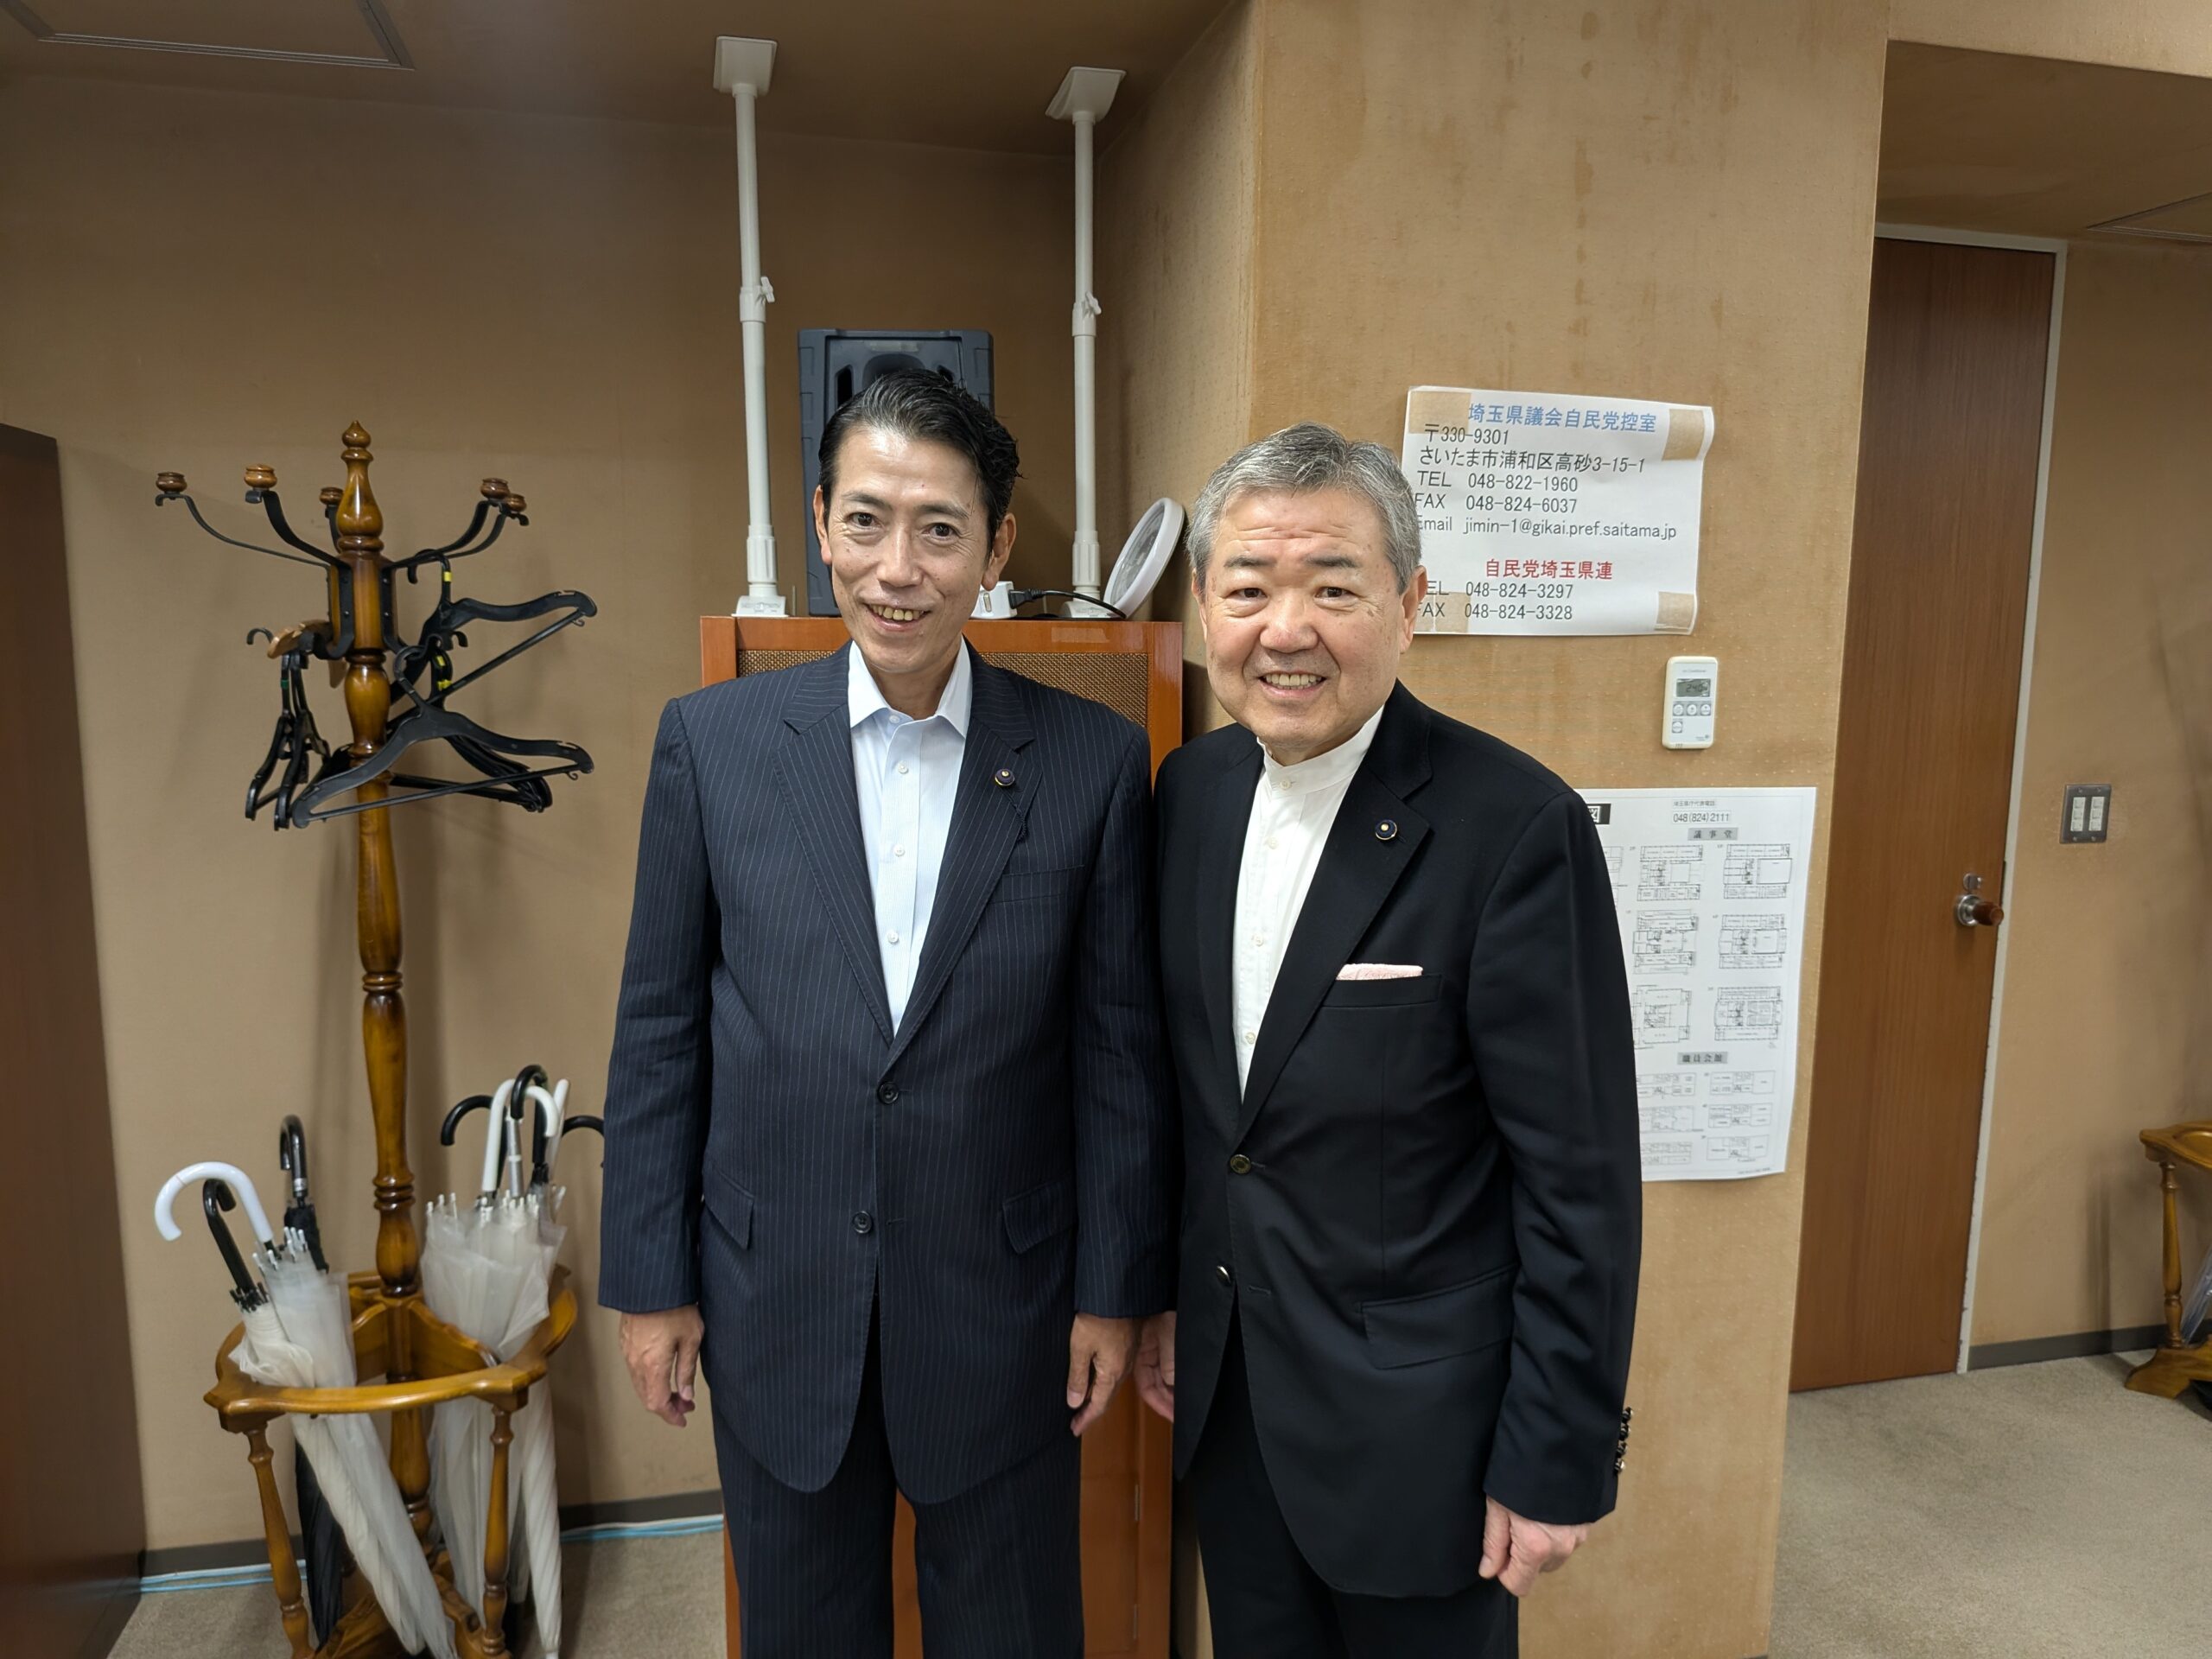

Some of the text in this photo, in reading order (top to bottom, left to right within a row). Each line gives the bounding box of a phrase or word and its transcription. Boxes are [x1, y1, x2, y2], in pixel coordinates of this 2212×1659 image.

[1468, 404, 1656, 433] 埼玉県議会自民党控室
[1425, 423, 1509, 445] 〒330-9301
[1420, 445, 1645, 474] さいたま市浦和区高砂3-15-1
[1417, 470, 1579, 493] TEL 048-822-1960
[1414, 493, 1578, 513] FAX 048-824-6037
[1463, 517, 1676, 541] jimin-1@gikai.pref.saitama.jp
[1485, 559, 1613, 580] 自民党埼玉県連
[1426, 580, 1574, 599] EL 048-824-3297
[1464, 603, 1573, 620] 048-824-3328
[1673, 812, 1729, 823] 048(824)2111
